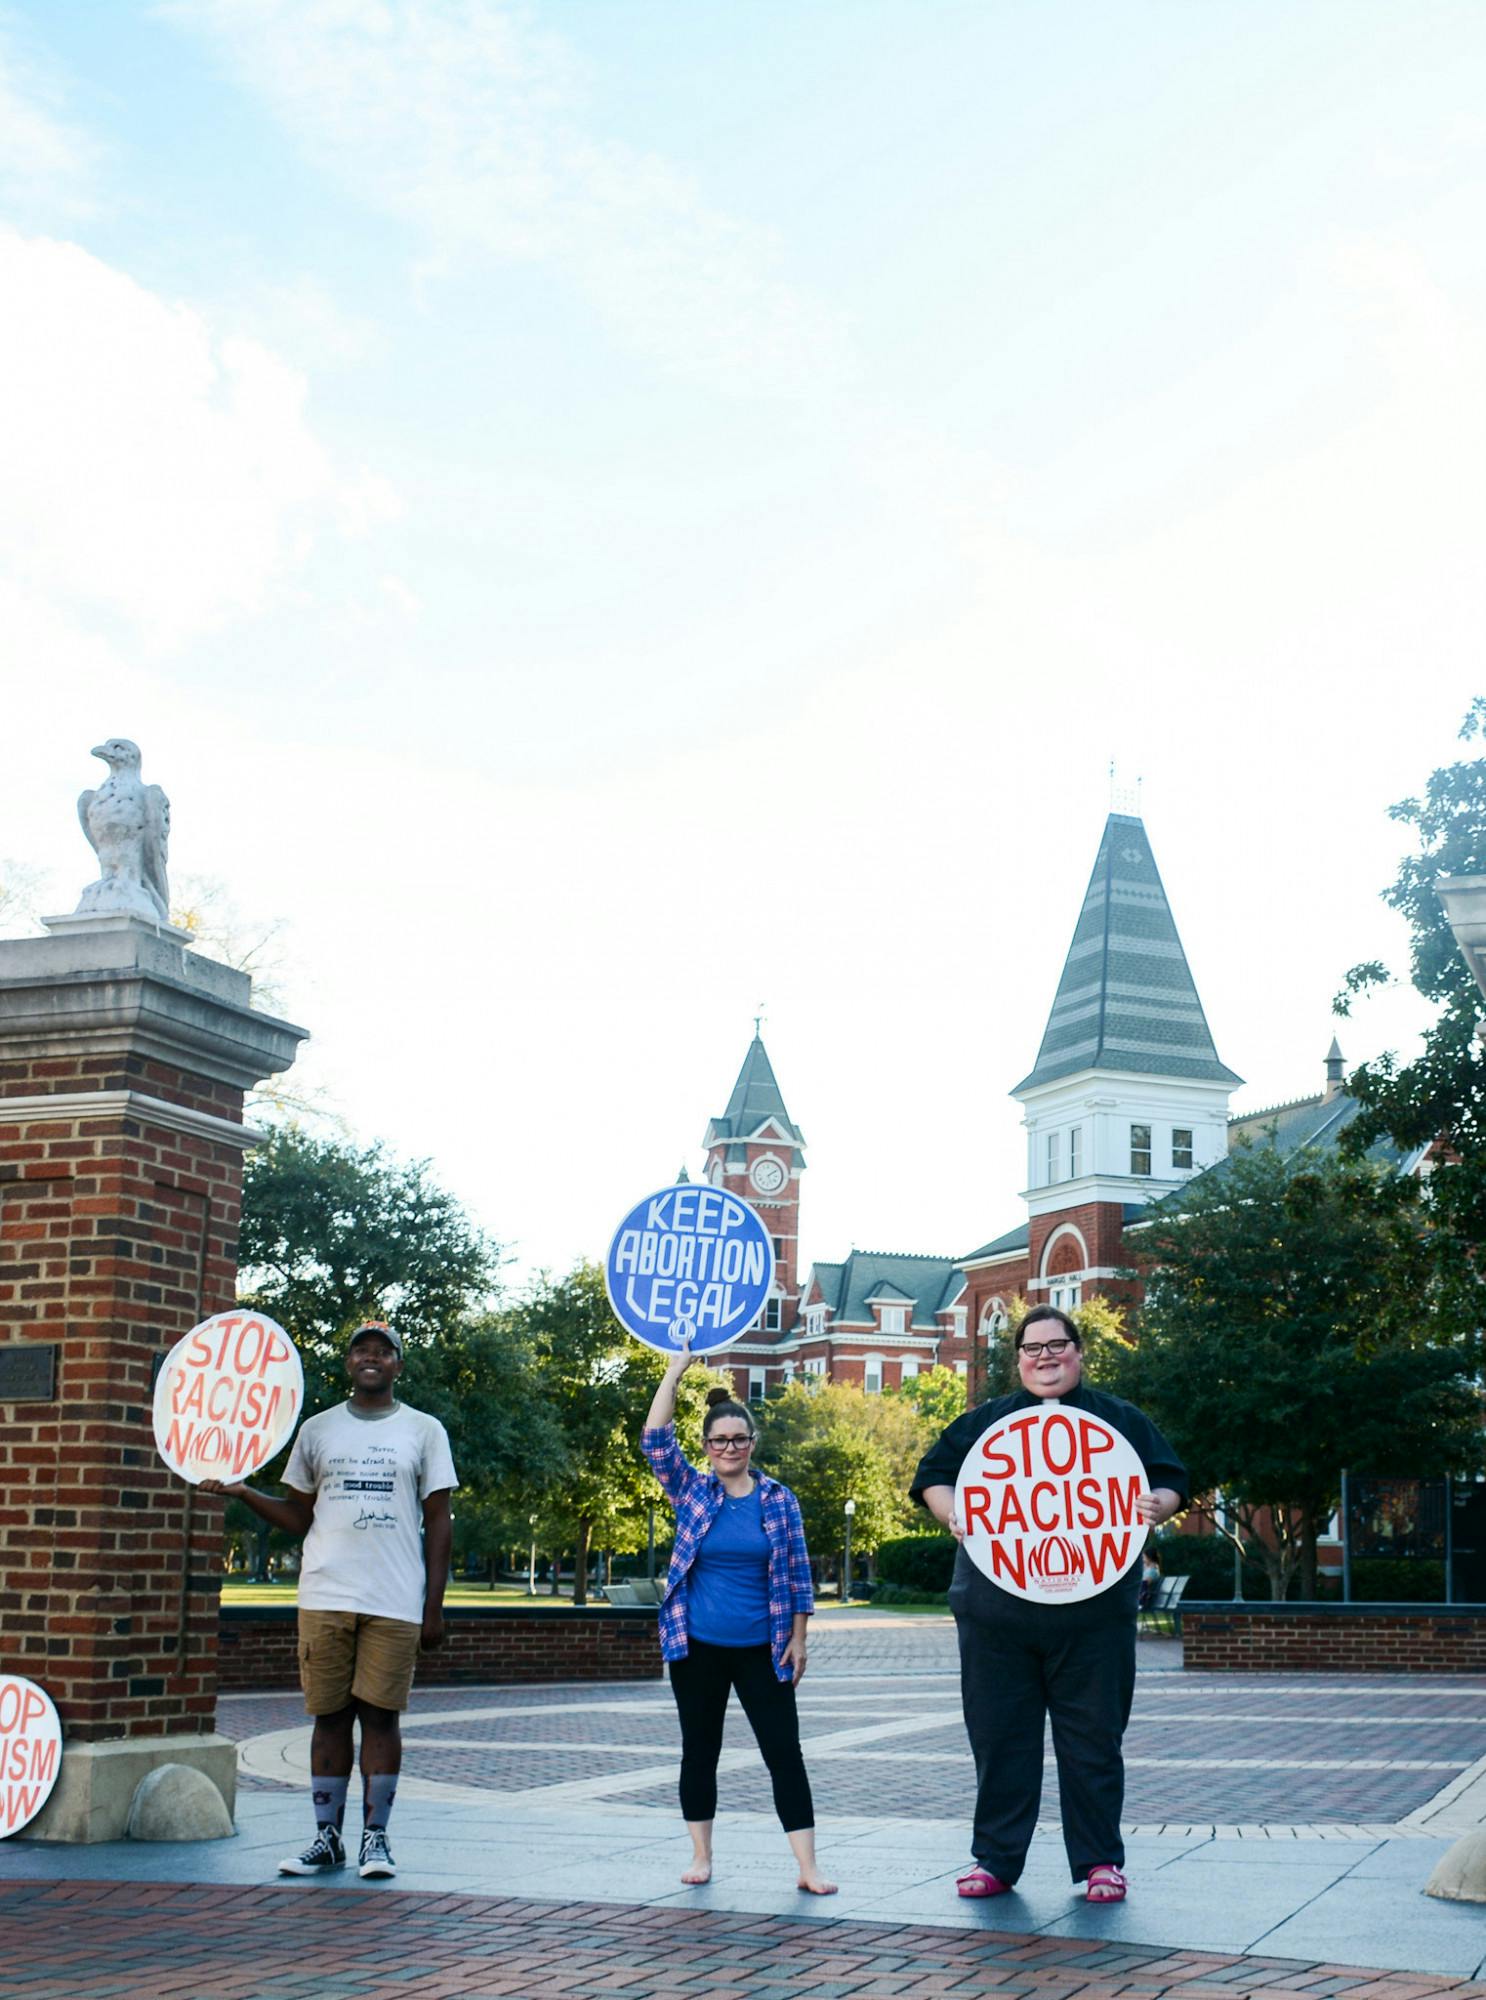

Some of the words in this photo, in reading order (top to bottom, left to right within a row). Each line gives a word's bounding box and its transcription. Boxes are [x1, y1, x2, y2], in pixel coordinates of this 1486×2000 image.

[647, 1190, 746, 1236] KEEP
[615, 1229, 765, 1286] ABORTION
[626, 1276, 747, 1329] LEGAL
[186, 1318, 290, 1378] STOP
[982, 1414, 1114, 1480] STOP
[963, 1475, 1144, 1536] RACISM
[0, 1683, 46, 1734] OP
[0, 1738, 57, 1782] ISM
